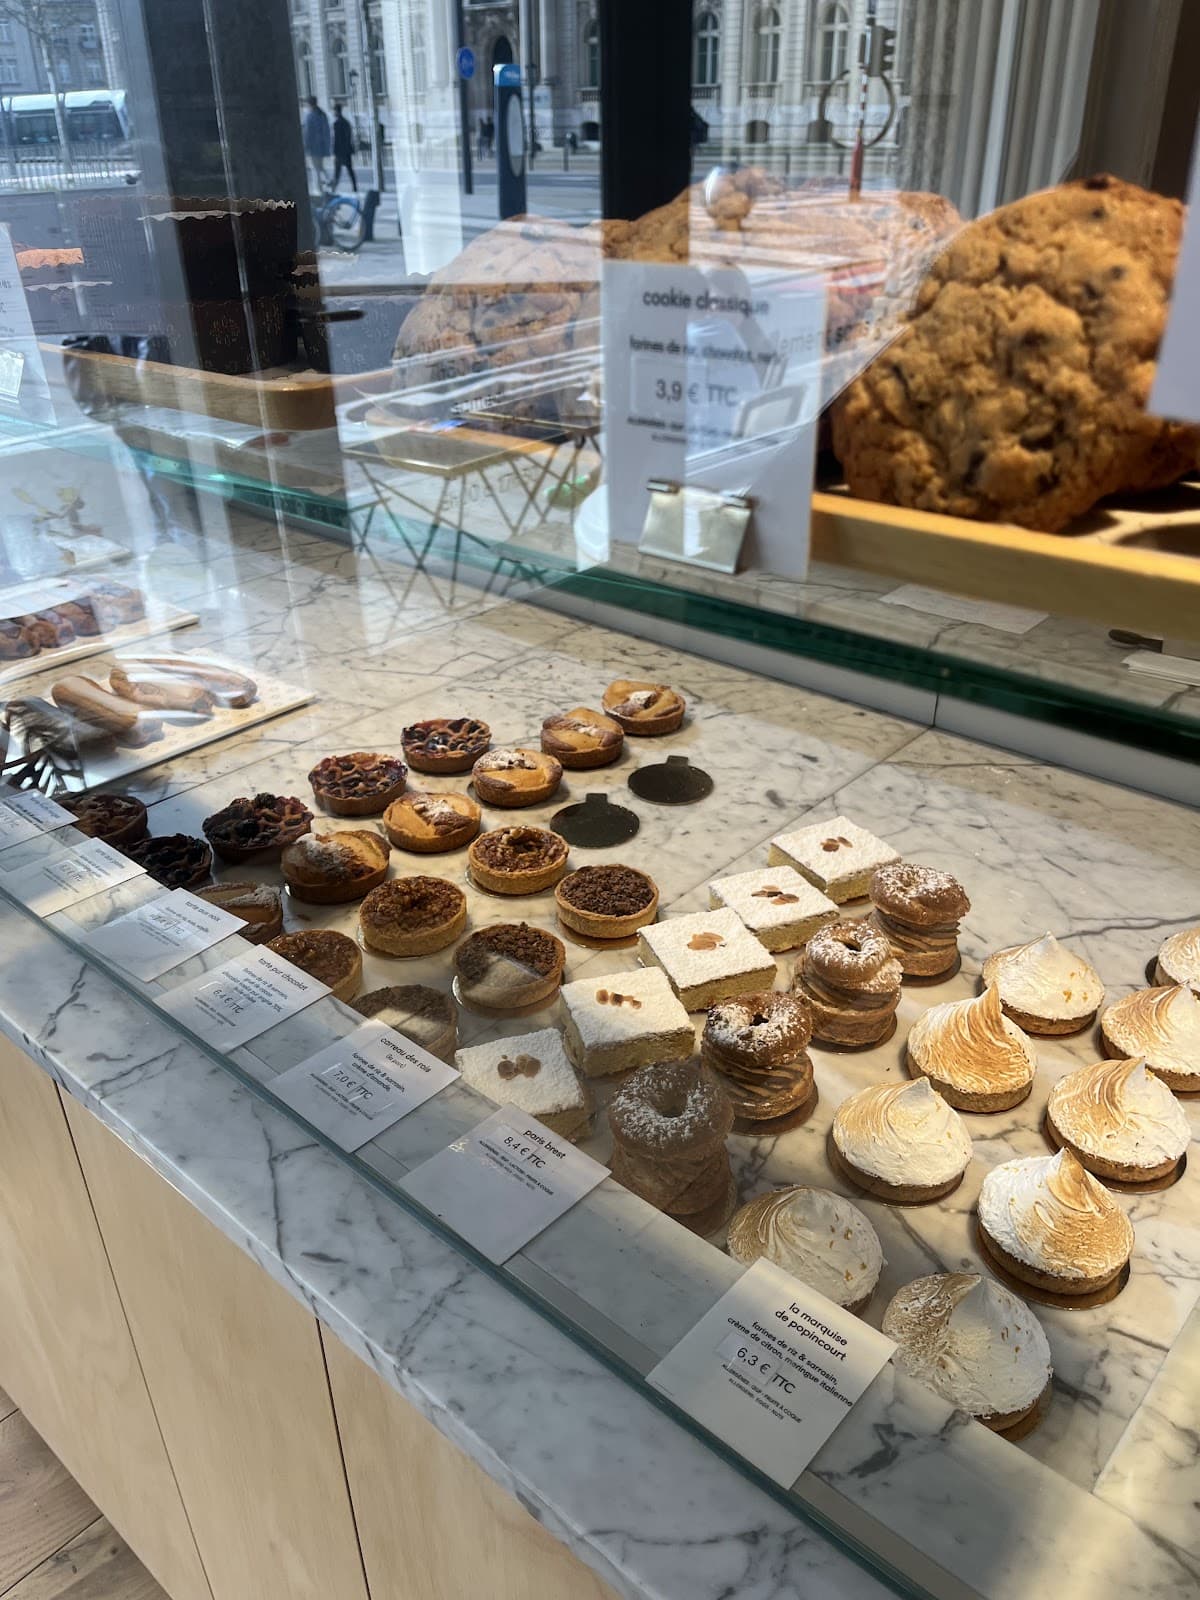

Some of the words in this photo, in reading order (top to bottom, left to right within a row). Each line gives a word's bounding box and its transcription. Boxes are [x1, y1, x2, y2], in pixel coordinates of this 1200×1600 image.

[643, 288, 692, 309] cookie
[696, 289, 769, 318] classique
[656, 379, 682, 403] 3,9
[688, 383, 699, 404] €
[708, 383, 738, 407] TTC
[281, 974, 308, 991] chocolat
[229, 1002, 244, 1013] TTC
[380, 1038, 407, 1056] carreau
[405, 1054, 418, 1064] des
[417, 1063, 431, 1072] rois
[333, 1070, 349, 1082] 7,0
[356, 1085, 373, 1100] TTC
[504, 1137, 521, 1150] 8,4
[527, 1153, 546, 1168] TTC
[523, 1130, 545, 1145] paris
[544, 1141, 566, 1159] brest
[775, 1310, 789, 1322] de
[787, 1321, 846, 1361] popincourt
[789, 1302, 800, 1314] la
[800, 1313, 847, 1346] marquise
[728, 1318, 750, 1334] crème
[750, 1333, 760, 1342] de
[761, 1341, 783, 1359] citron,
[784, 1357, 819, 1383] meringue
[819, 1380, 853, 1407] italienne
[752, 1321, 776, 1342] farines
[777, 1340, 787, 1349] de
[787, 1347, 798, 1356] riz
[806, 1360, 837, 1385] sarrasin,
[737, 1348, 758, 1366] 6,3
[760, 1363, 771, 1374] €
[772, 1373, 796, 1394] TTC
